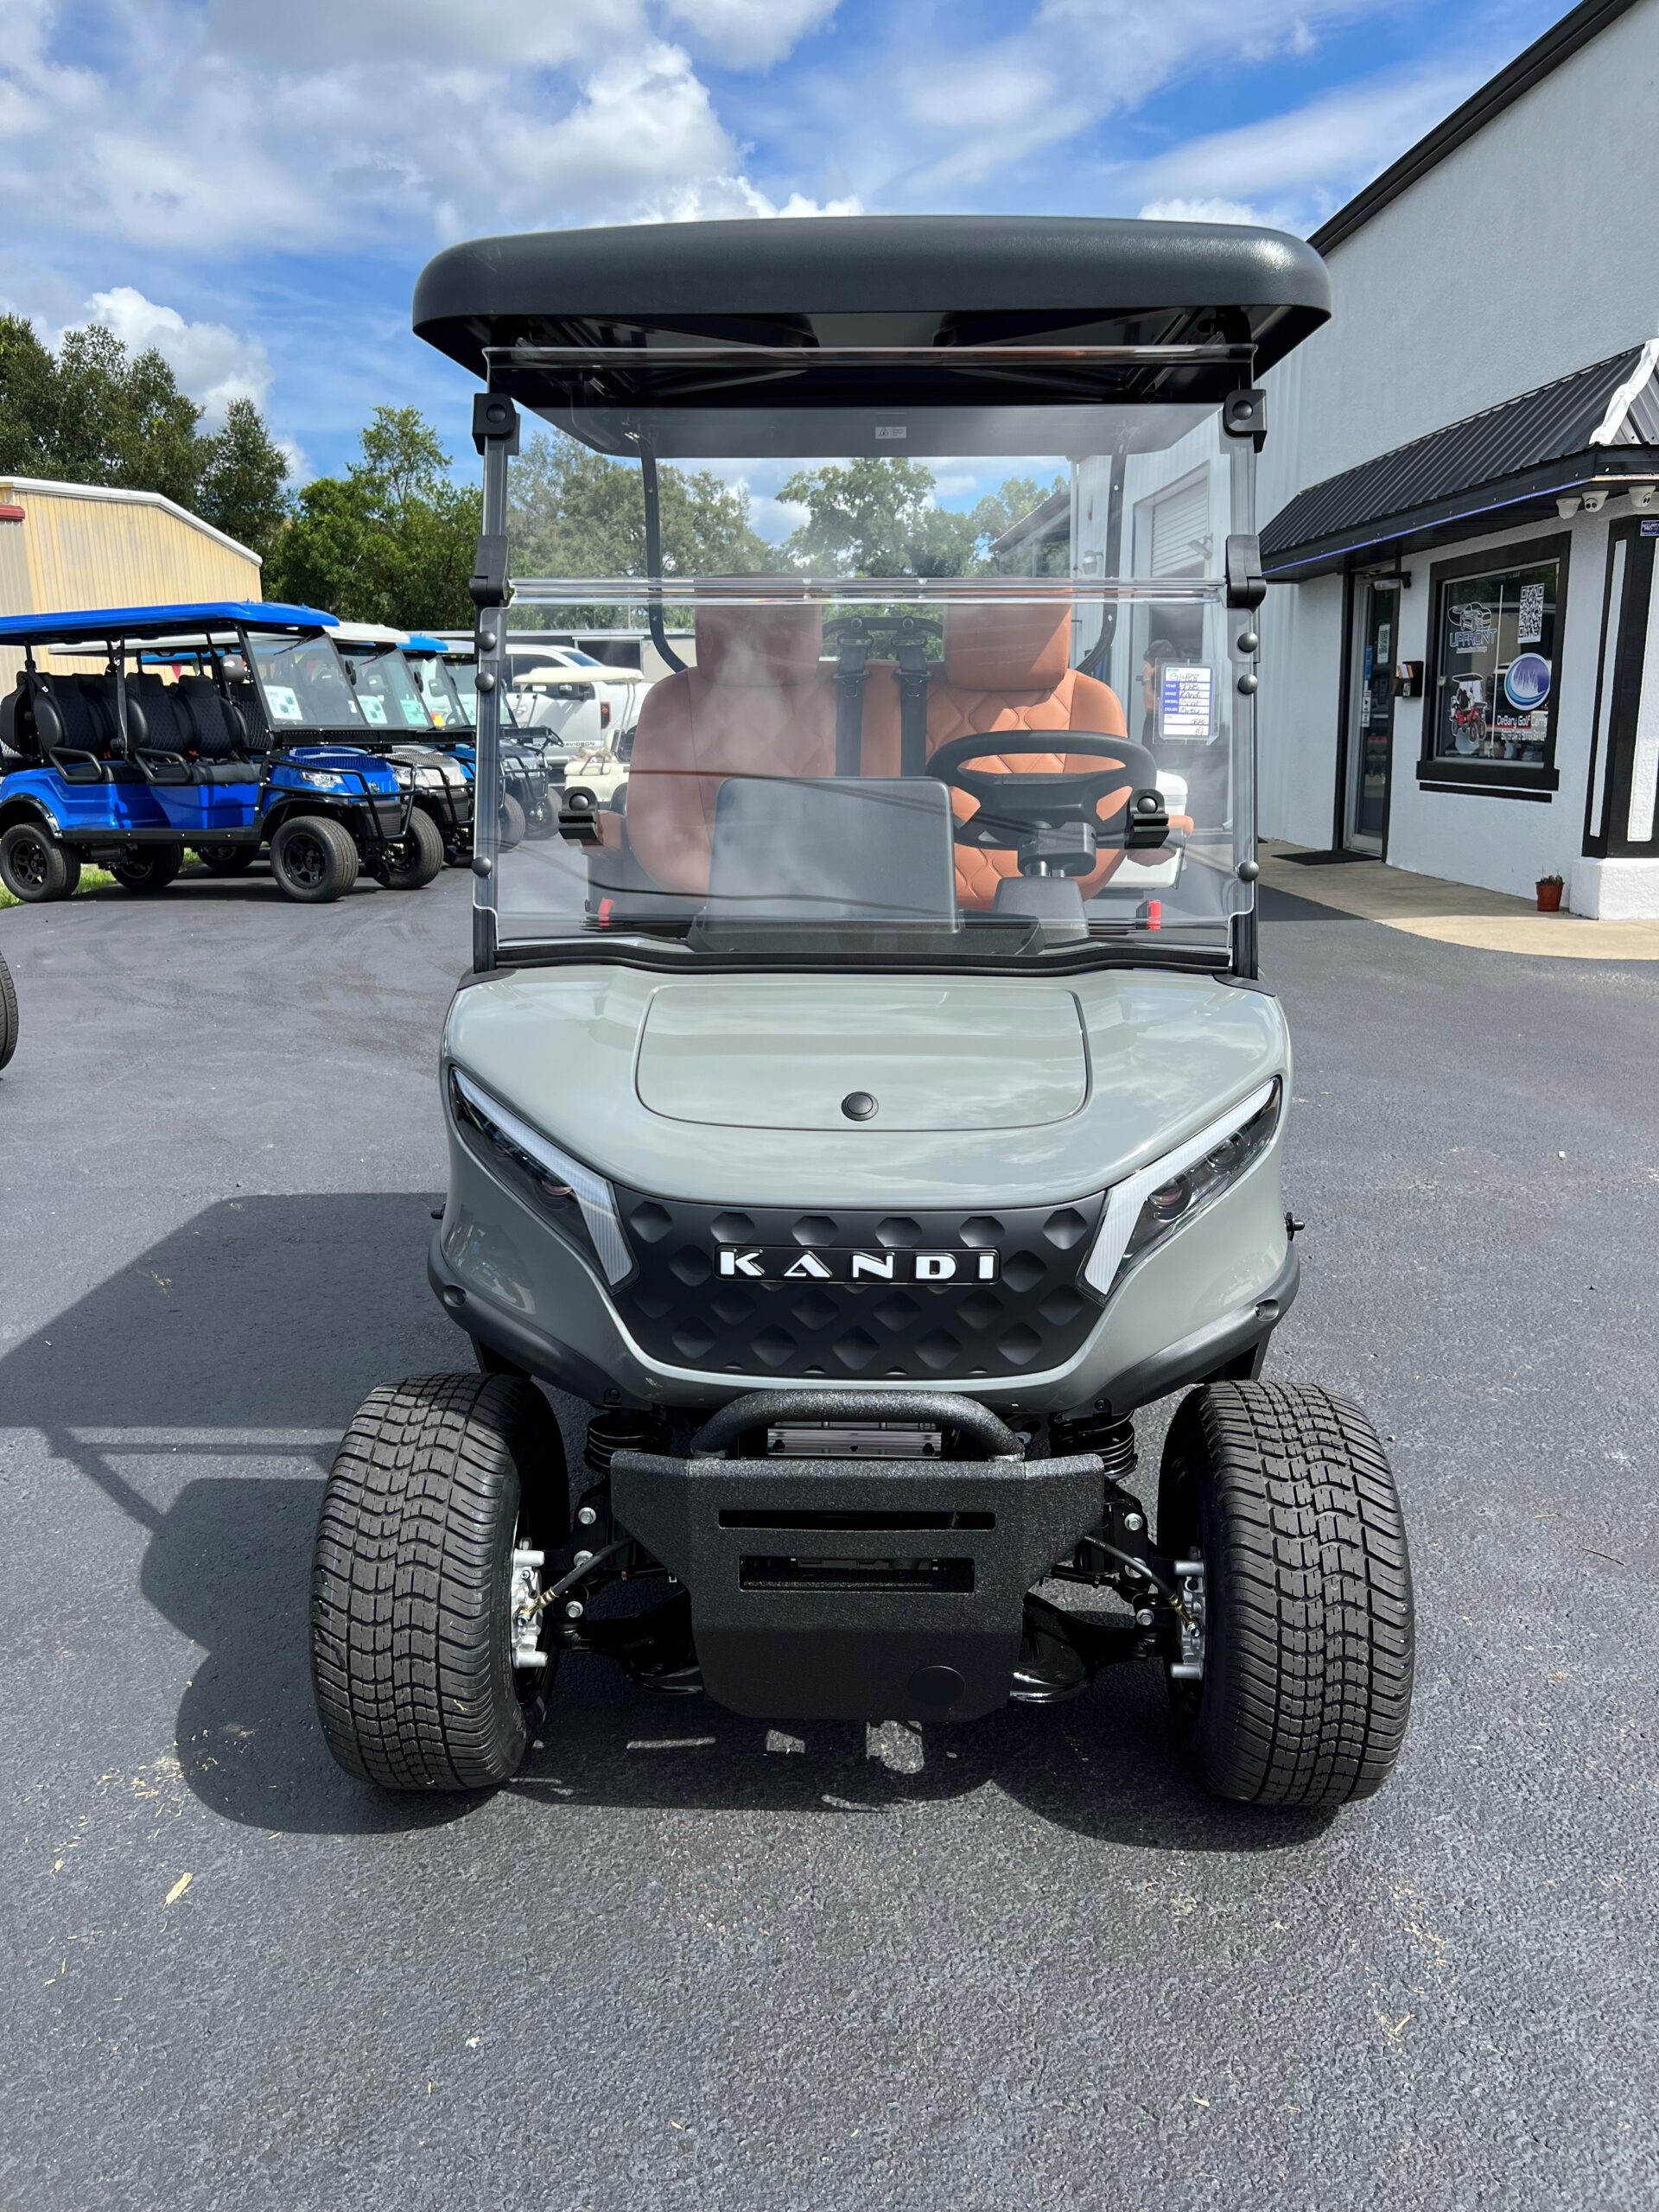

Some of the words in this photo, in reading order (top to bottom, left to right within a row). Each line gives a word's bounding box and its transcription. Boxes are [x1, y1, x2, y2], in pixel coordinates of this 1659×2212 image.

[1497, 715, 1517, 729] DeBary
[1518, 715, 1531, 726] Golf
[719, 1249, 995, 1280] KANDI
